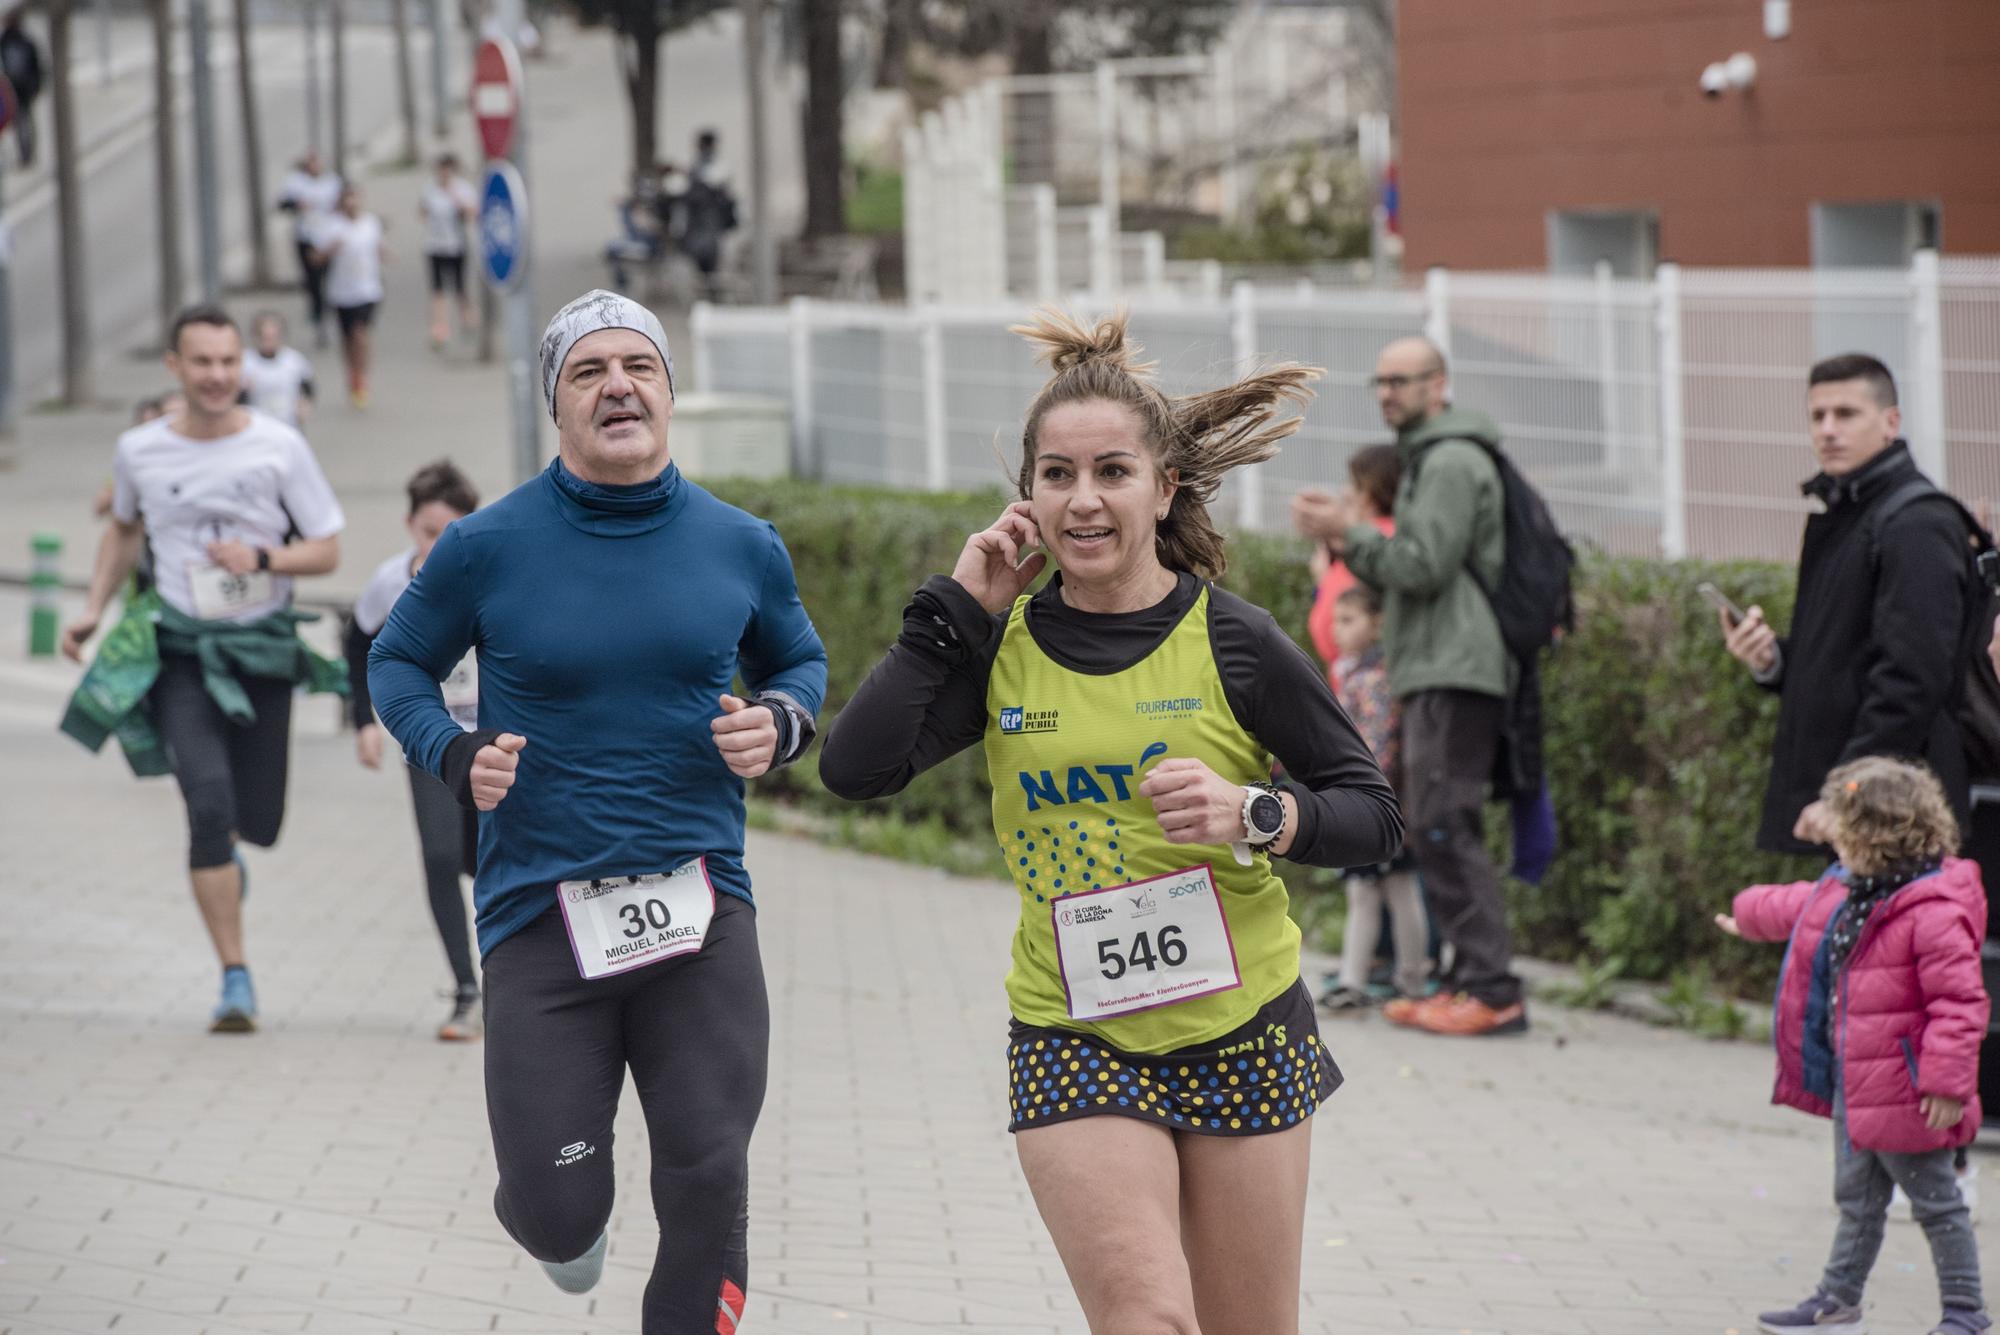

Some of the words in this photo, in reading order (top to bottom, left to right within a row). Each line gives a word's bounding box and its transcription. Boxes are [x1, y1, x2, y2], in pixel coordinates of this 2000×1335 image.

[1025, 709, 1058, 720] RUBIÓ
[1025, 720, 1058, 729] PUBILL
[1081, 904, 1103, 913] CURSA
[1093, 908, 1113, 917] DONA
[618, 898, 672, 939] 30
[1076, 914, 1106, 924] MANRESA
[605, 937, 655, 959] MIGUEL
[658, 926, 700, 943] ANGEL
[1097, 925, 1188, 980] 546
